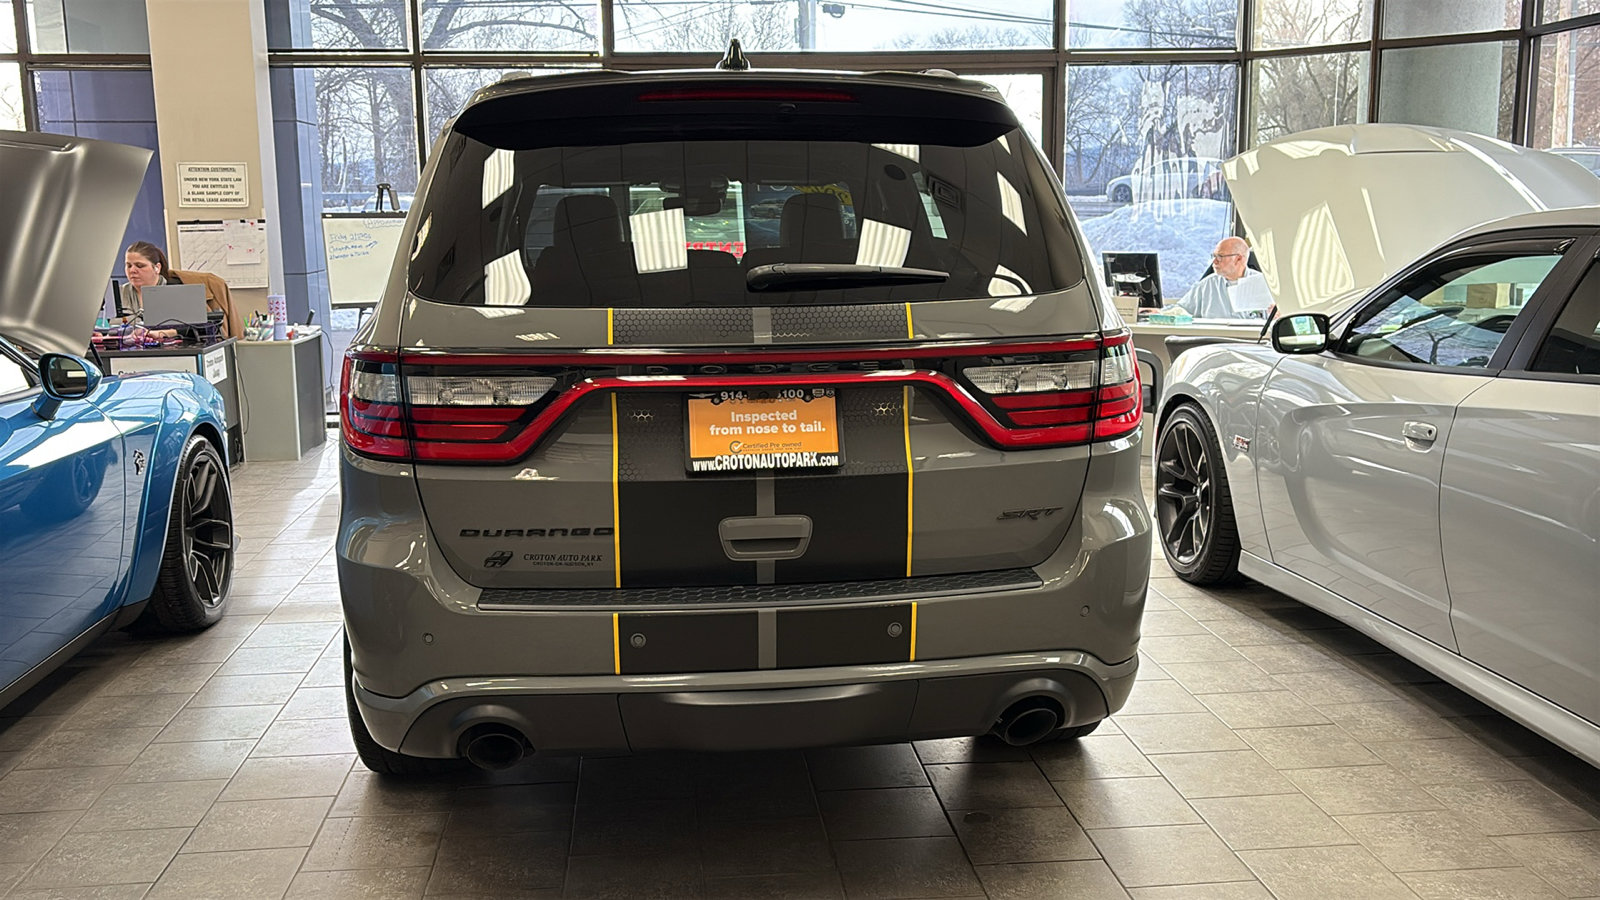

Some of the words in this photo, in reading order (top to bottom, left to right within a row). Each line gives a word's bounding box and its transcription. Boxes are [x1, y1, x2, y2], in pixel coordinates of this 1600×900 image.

[646, 360, 880, 374] DODGE
[731, 410, 797, 424] Inspected
[709, 424, 742, 436] from
[746, 425, 778, 434] nose
[782, 424, 796, 432] to
[800, 421, 826, 432] tail.
[996, 506, 1064, 520] SRT
[460, 528, 614, 537] DURANGO
[523, 553, 556, 561] CROTON
